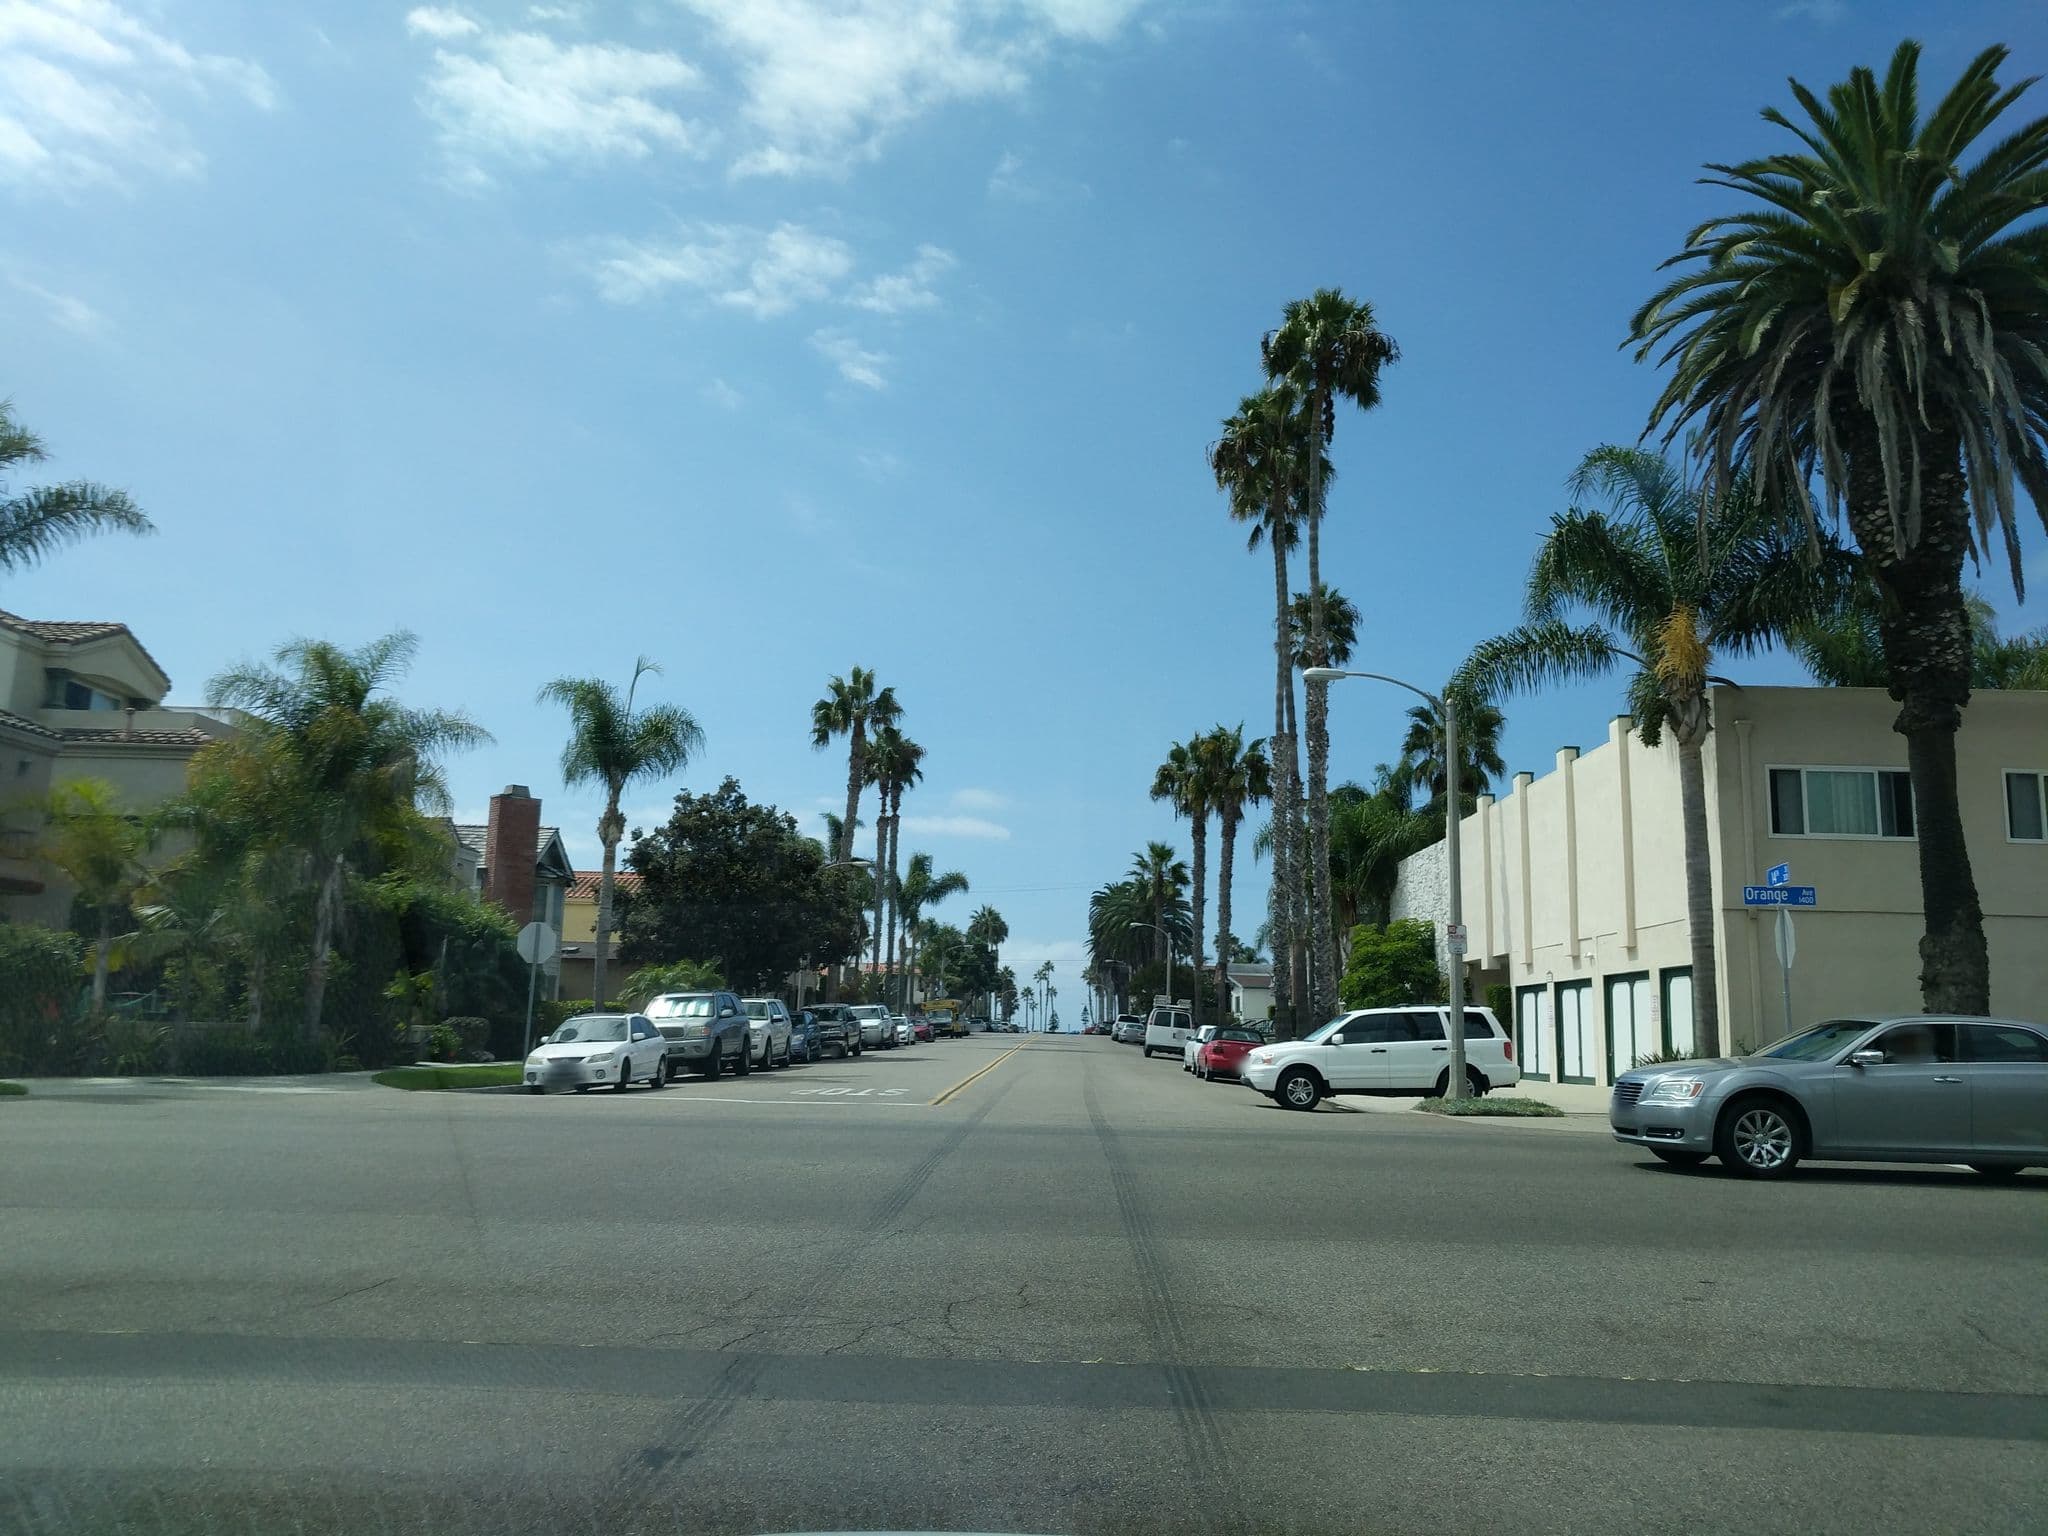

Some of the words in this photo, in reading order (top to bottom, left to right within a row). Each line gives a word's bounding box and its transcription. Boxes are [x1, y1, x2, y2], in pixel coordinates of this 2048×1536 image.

[1745, 887, 1788, 904] Orange
[1801, 888, 1814, 896] Ave
[789, 1087, 911, 1096] STOP
